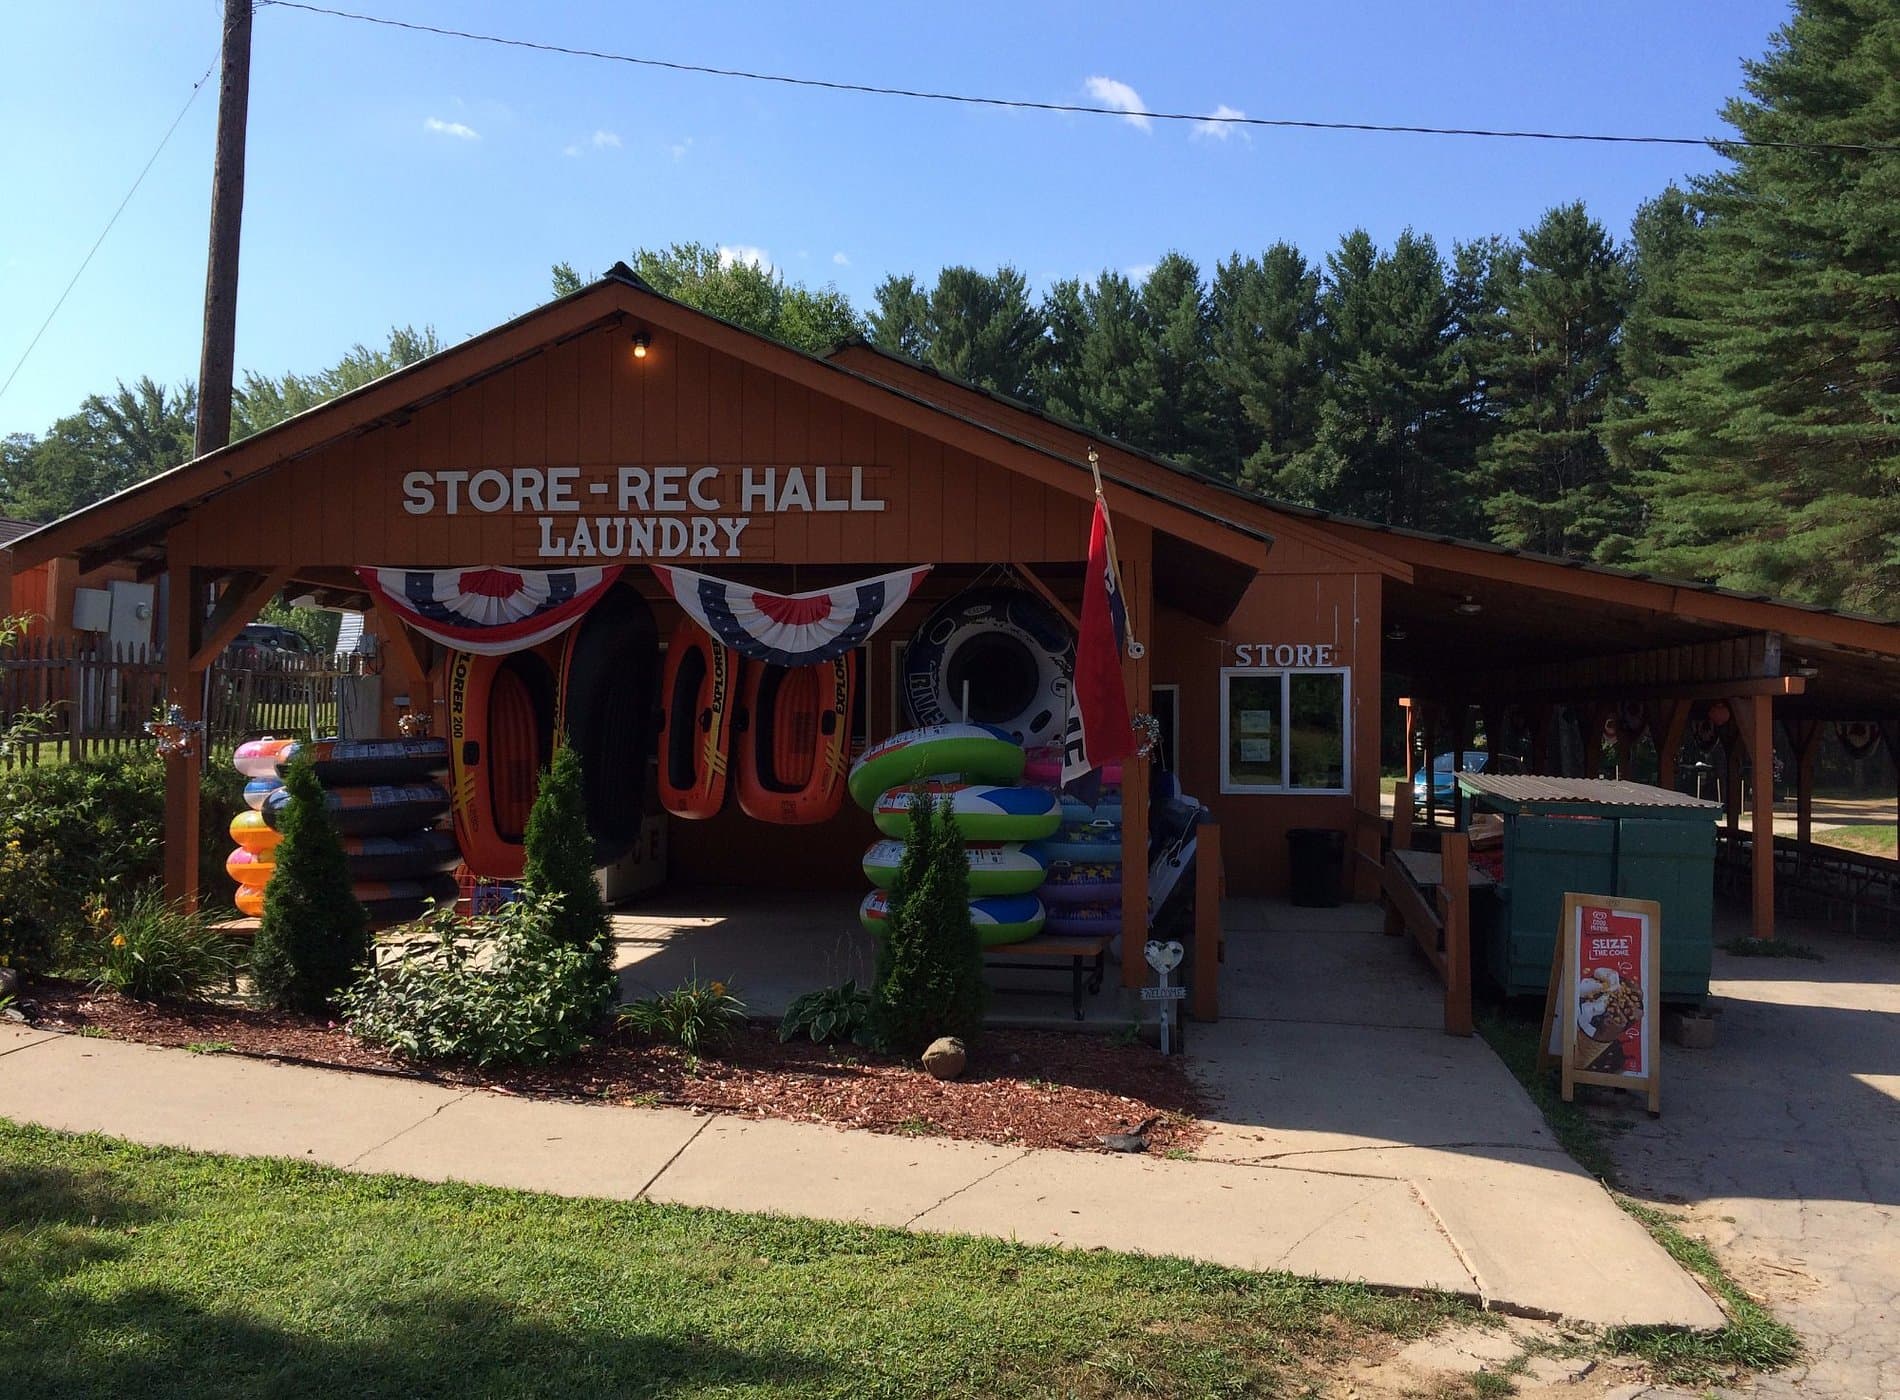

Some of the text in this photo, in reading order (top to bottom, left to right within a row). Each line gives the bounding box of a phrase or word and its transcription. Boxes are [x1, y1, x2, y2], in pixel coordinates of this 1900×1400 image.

[741, 466, 886, 513] HALL
[538, 516, 750, 558] LAUNDRY
[1235, 643, 1333, 667] STORE
[834, 656, 846, 715] EXPLOR
[452, 716, 464, 738] 200
[1591, 938, 1629, 949] SEIZE
[1593, 949, 1608, 957] THE
